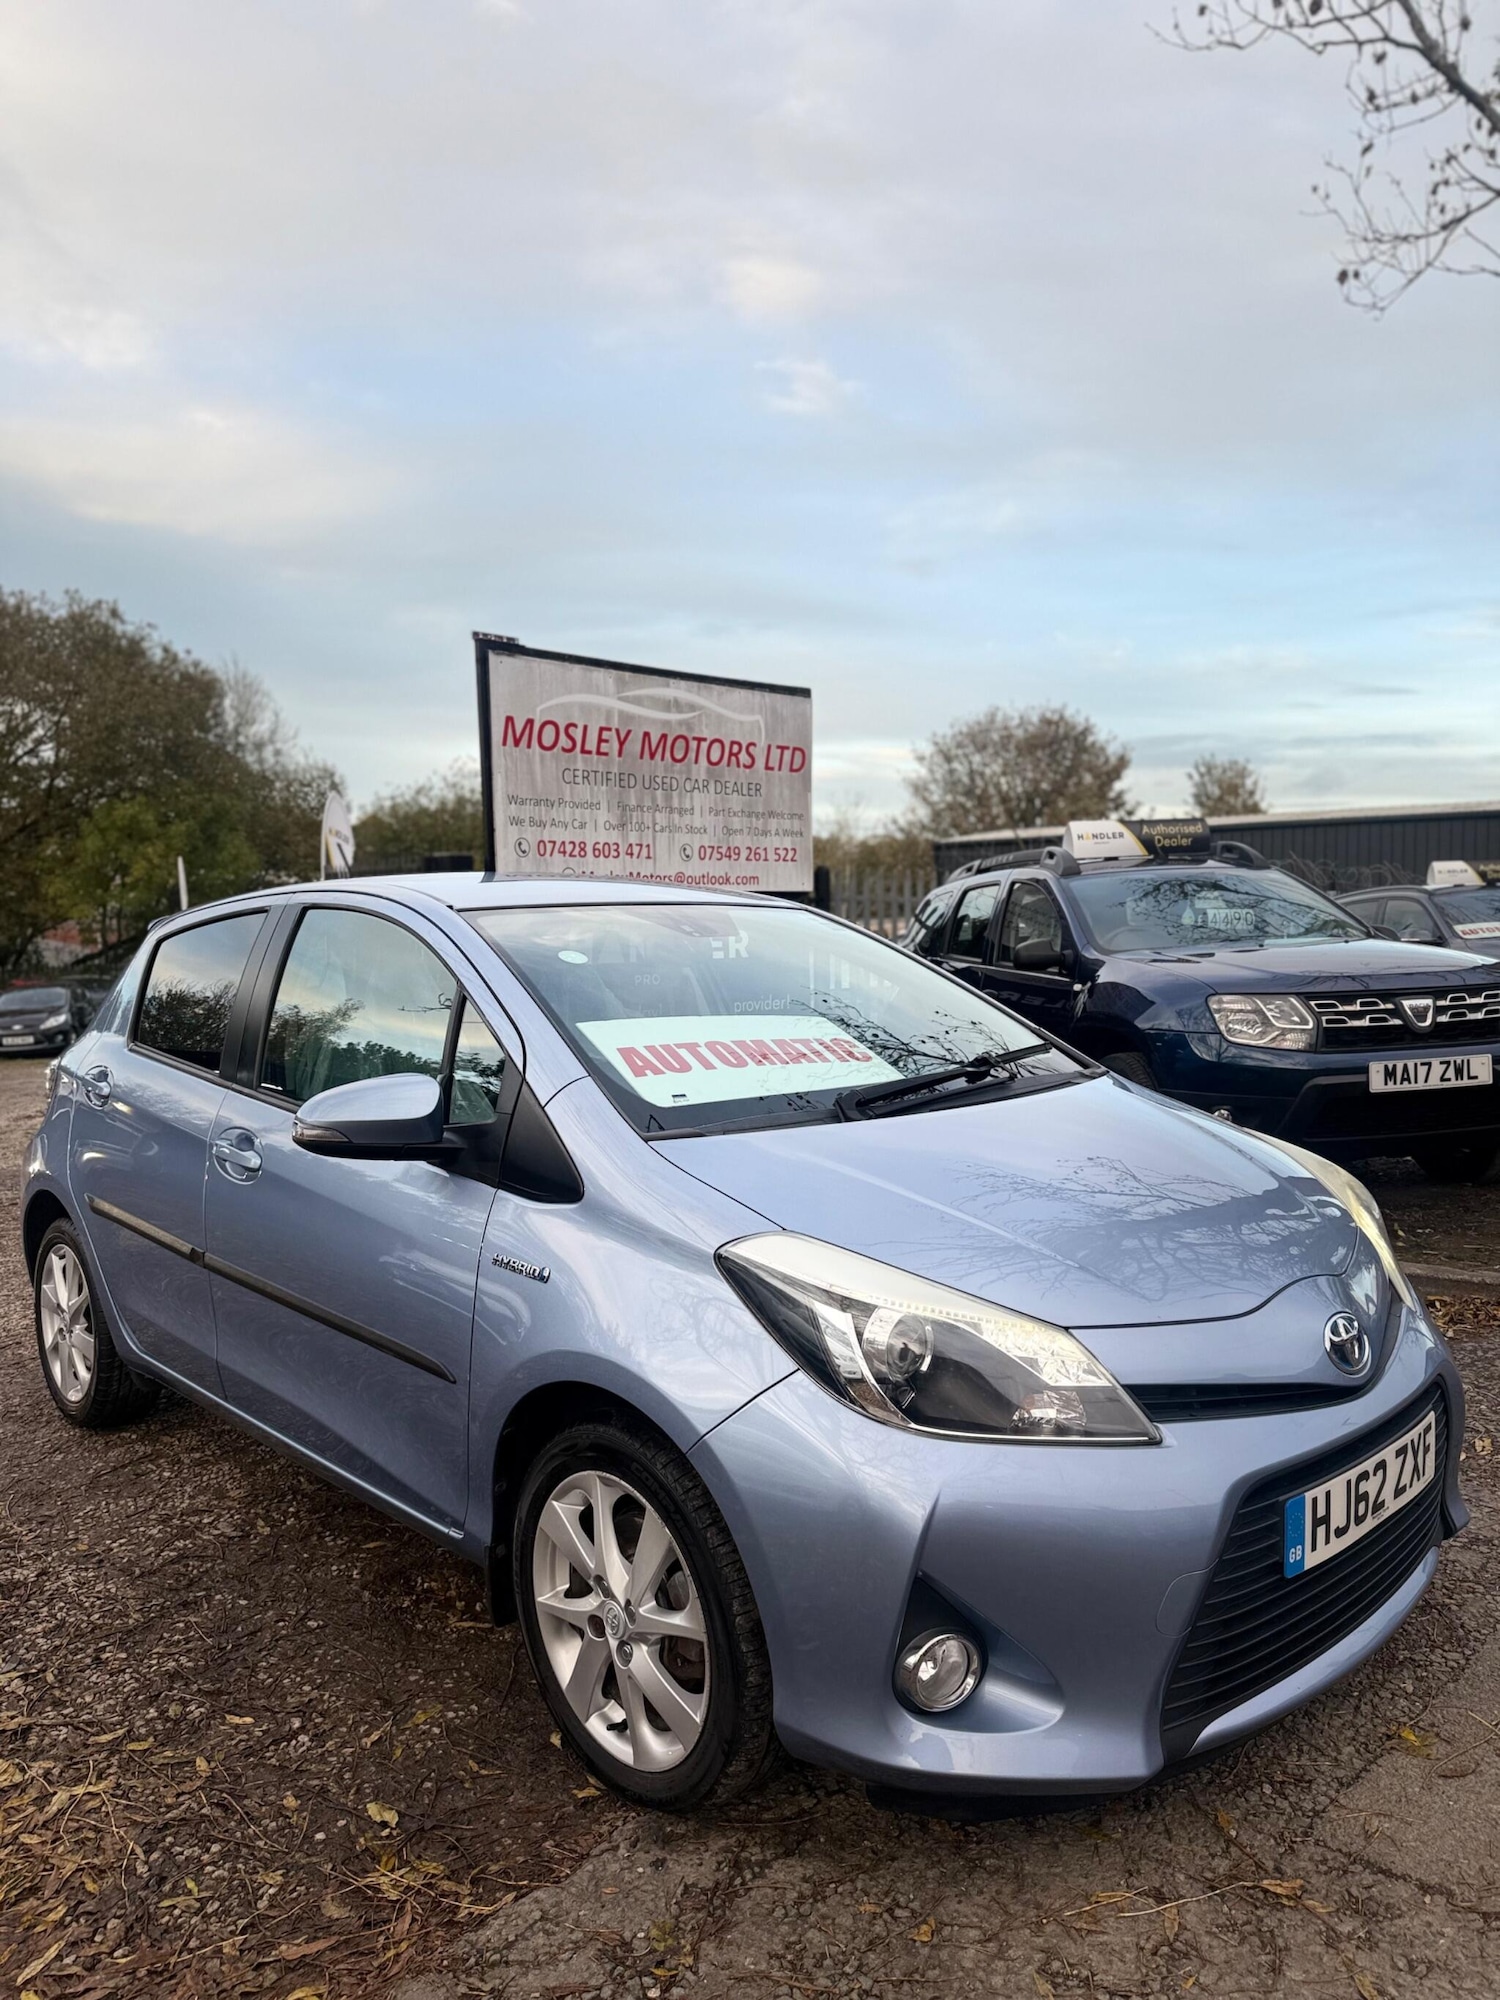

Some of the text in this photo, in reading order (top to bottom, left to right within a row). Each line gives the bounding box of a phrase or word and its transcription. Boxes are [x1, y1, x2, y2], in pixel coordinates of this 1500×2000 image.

[501, 715, 807, 774] MOSLEY MOTORS LTD
[561, 767, 763, 798] CERTIFIED USED CAR DEALER
[507, 794, 601, 811] Warranty Provided
[616, 801, 695, 817] Finance Arranged
[708, 806, 805, 821] Part Exchange Welcome
[508, 815, 588, 831] We Buy Any Car
[603, 819, 708, 835] Over 100+ Cars In Stock
[721, 825, 804, 839] Open 7 Days A Week
[1142, 822, 1203, 835] Authorised
[536, 839, 653, 860] 07428 603 471
[1154, 835, 1193, 847] Dealer
[698, 845, 798, 863] 07549 261 522
[733, 993, 791, 1013] provider!
[615, 1037, 874, 1078] AUTOMATIC
[1383, 1058, 1479, 1087] MA17 ZWL
[1310, 1421, 1433, 1554] HJ62 ZXF
[1288, 1544, 1303, 1564] GB
